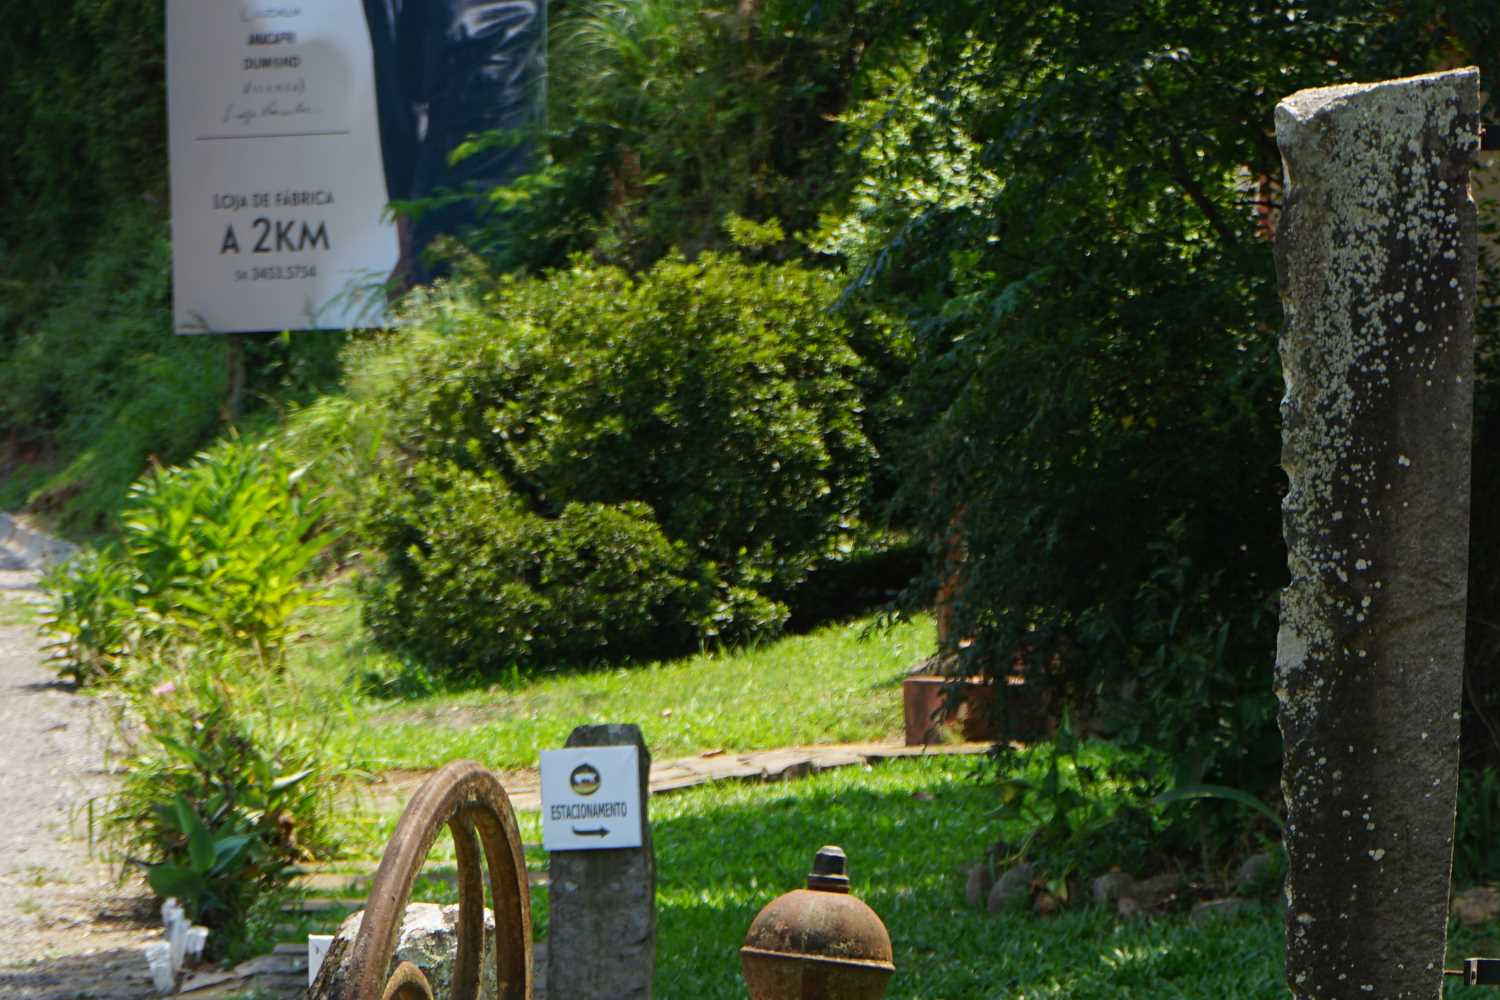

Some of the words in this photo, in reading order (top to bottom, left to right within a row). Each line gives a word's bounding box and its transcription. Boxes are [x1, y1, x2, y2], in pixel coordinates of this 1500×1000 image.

[212, 192, 248, 213] LOJA
[251, 191, 271, 209] DE
[219, 222, 241, 254] A
[251, 216, 331, 253] 2KM
[551, 801, 628, 821] ESTACIONAMENTO
